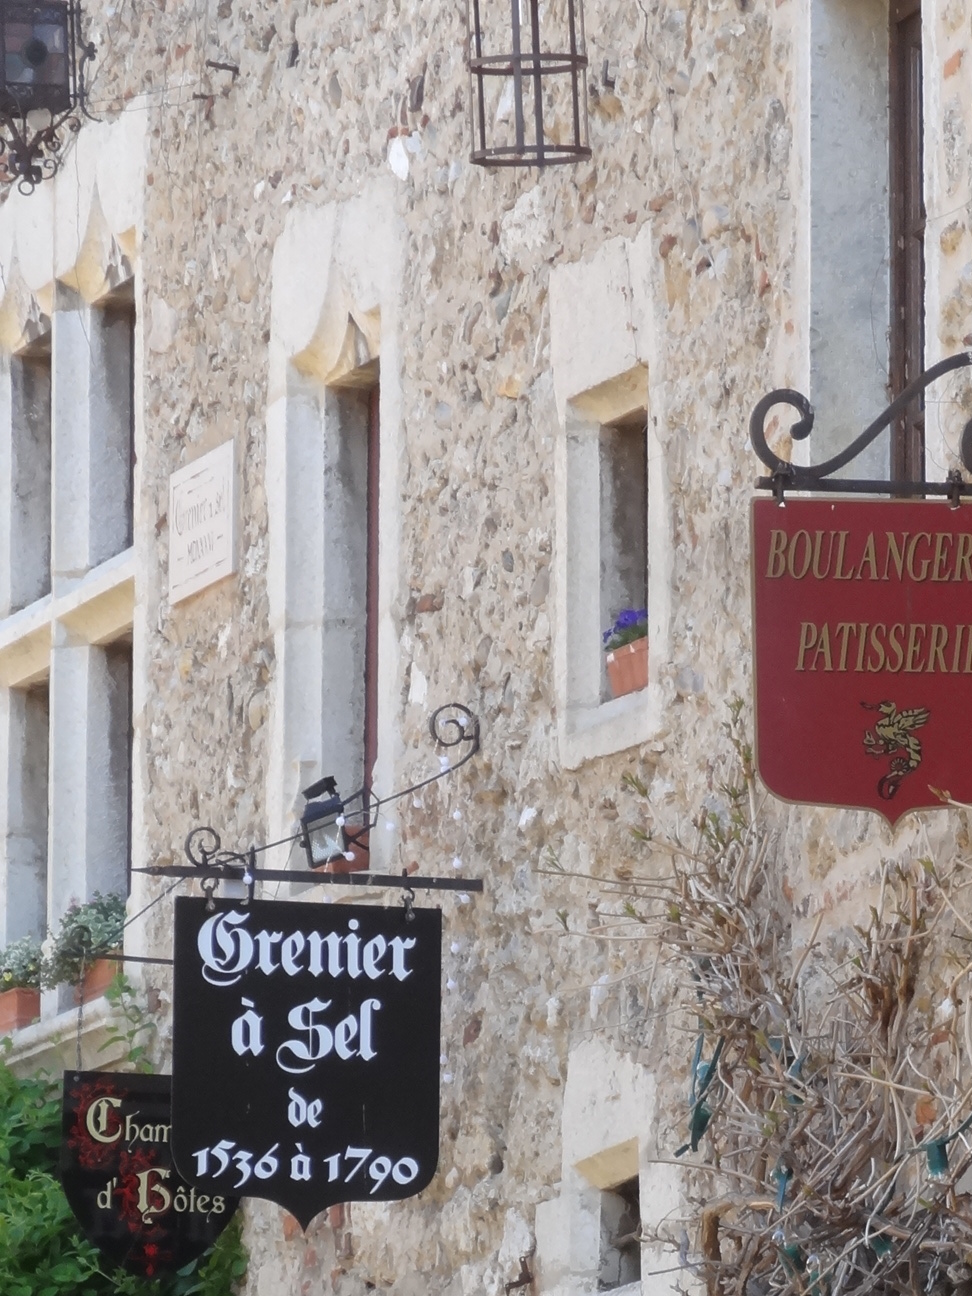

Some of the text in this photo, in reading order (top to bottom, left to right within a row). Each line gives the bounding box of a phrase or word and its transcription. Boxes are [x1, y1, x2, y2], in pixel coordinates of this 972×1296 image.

[197, 910, 416, 986] Grenier
[231, 996, 382, 1074] à Sel
[86, 1096, 172, 1153] Cham
[287, 1086, 323, 1129] de
[192, 1139, 420, 1195] 1536 à 1790
